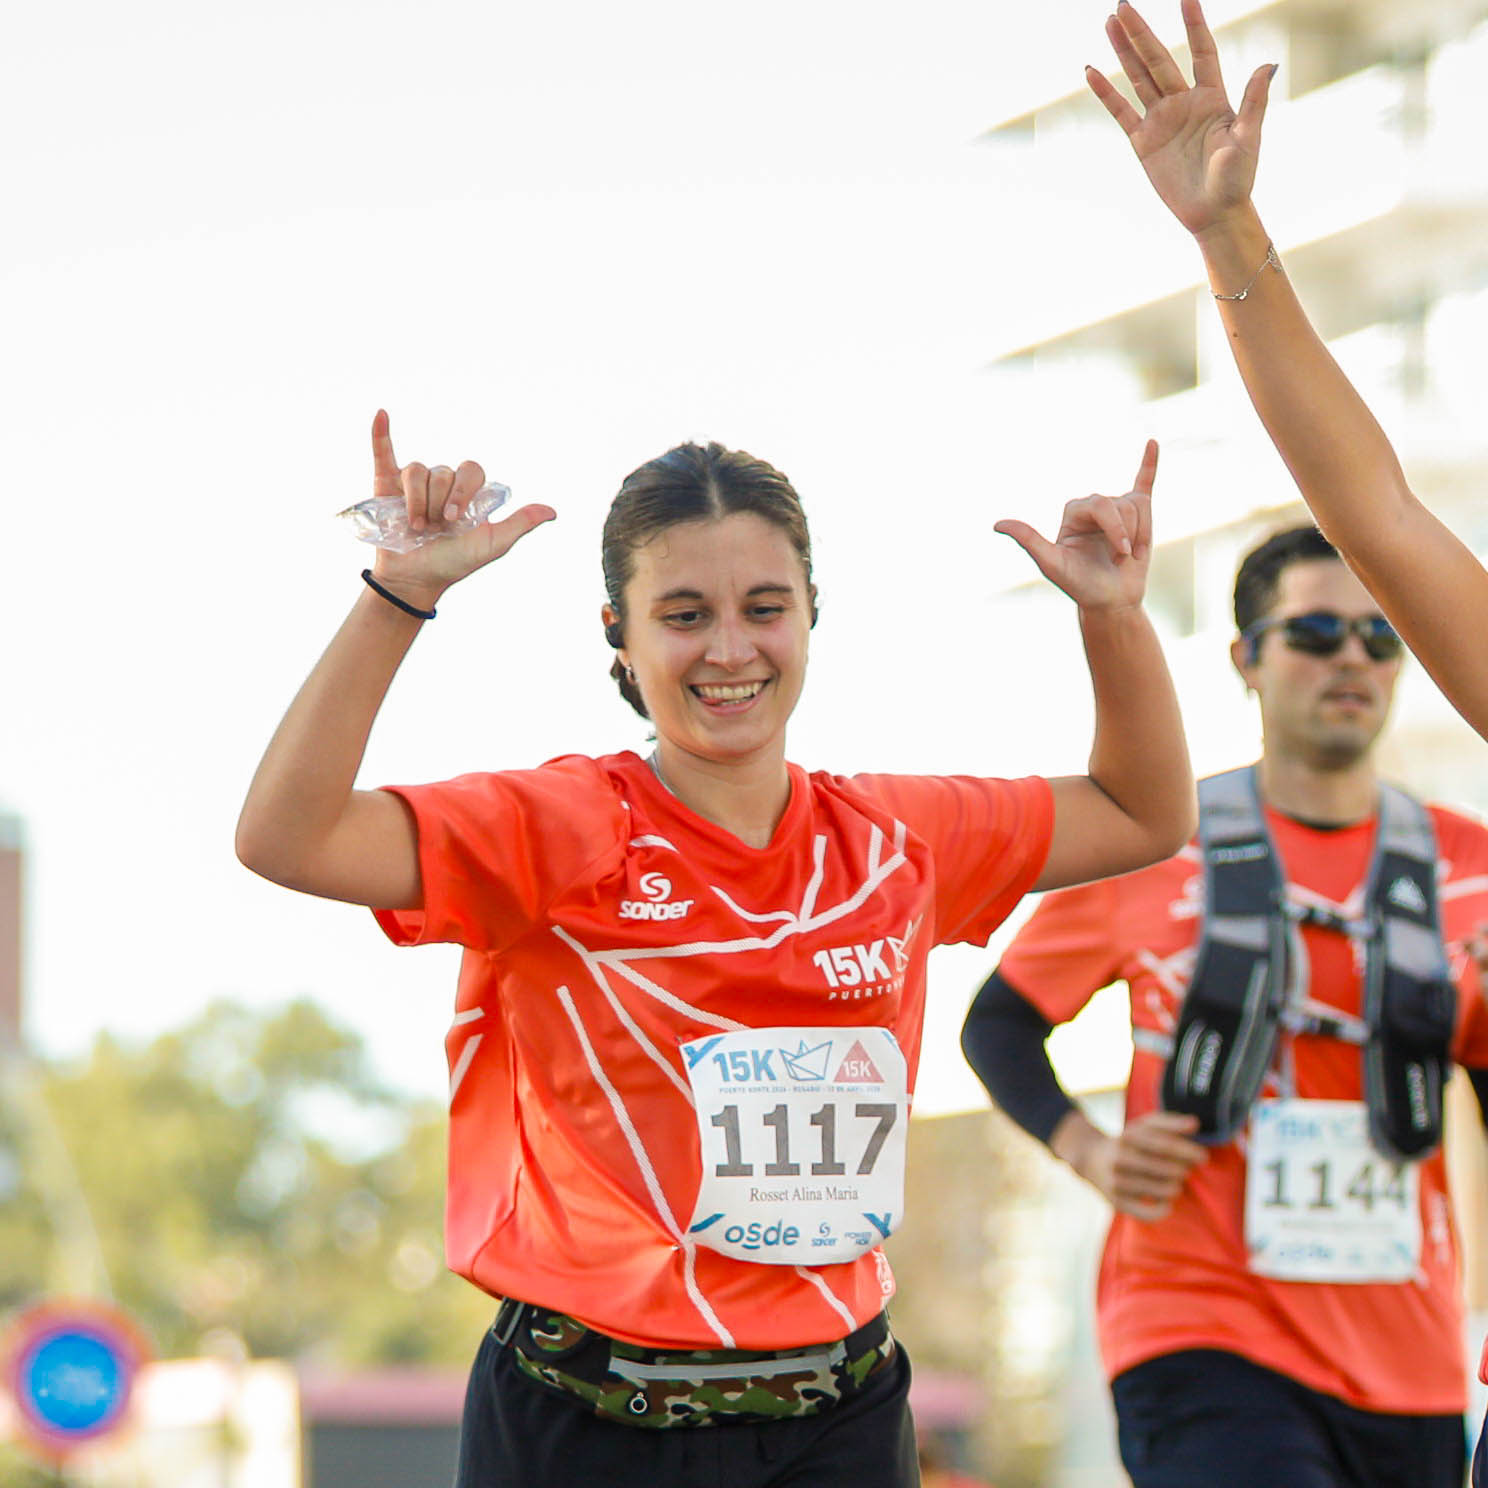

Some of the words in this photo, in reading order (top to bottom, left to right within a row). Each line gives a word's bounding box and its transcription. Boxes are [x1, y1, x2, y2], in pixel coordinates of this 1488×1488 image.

[813, 938, 892, 988] 15K
[828, 983, 893, 1001] PUERTO
[713, 1049, 777, 1082] 15K
[843, 1060, 872, 1078] 15K
[710, 1103, 898, 1177] 1117
[749, 1187, 790, 1202] Rosset
[792, 1187, 822, 1201] Alina
[825, 1186, 859, 1201] Maria
[724, 1218, 801, 1249] osde
